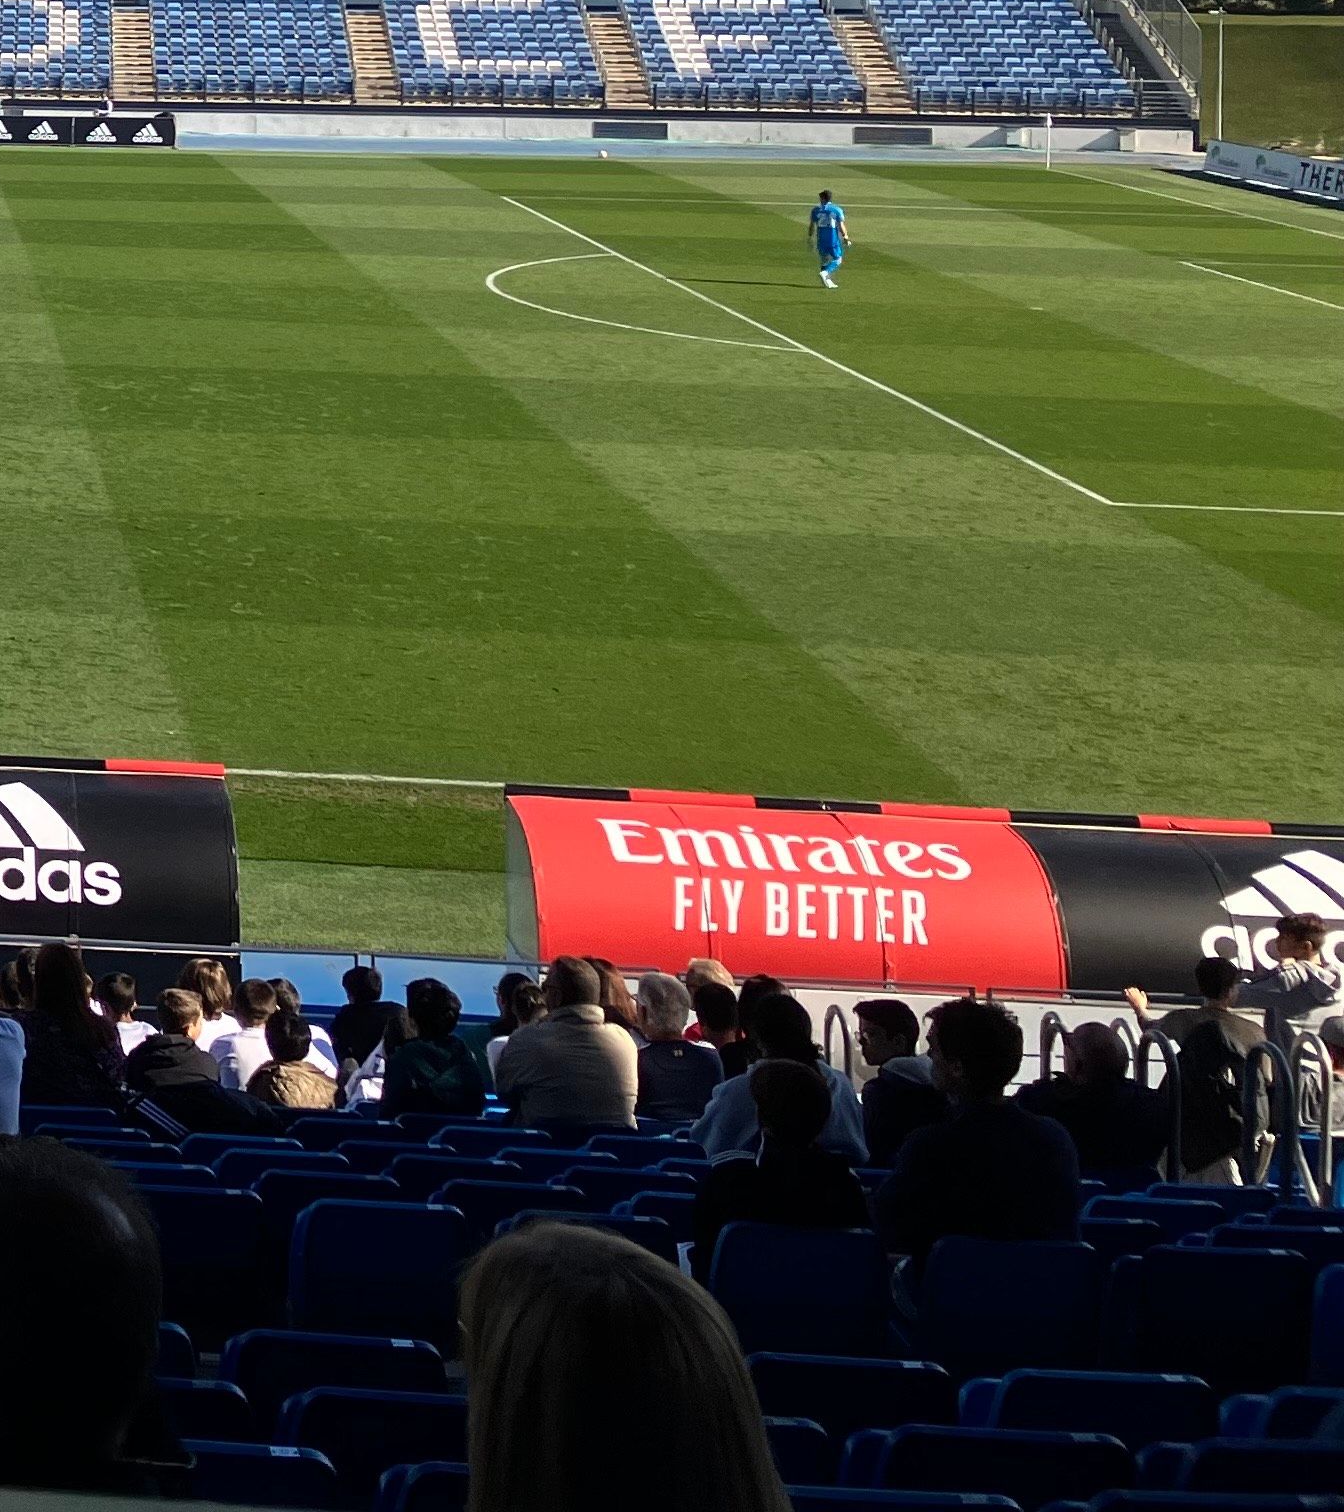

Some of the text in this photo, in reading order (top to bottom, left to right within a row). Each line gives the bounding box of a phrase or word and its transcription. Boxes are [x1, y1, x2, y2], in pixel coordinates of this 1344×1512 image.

[596, 818, 973, 880] Emirates
[674, 876, 930, 946] FLY BETTER
